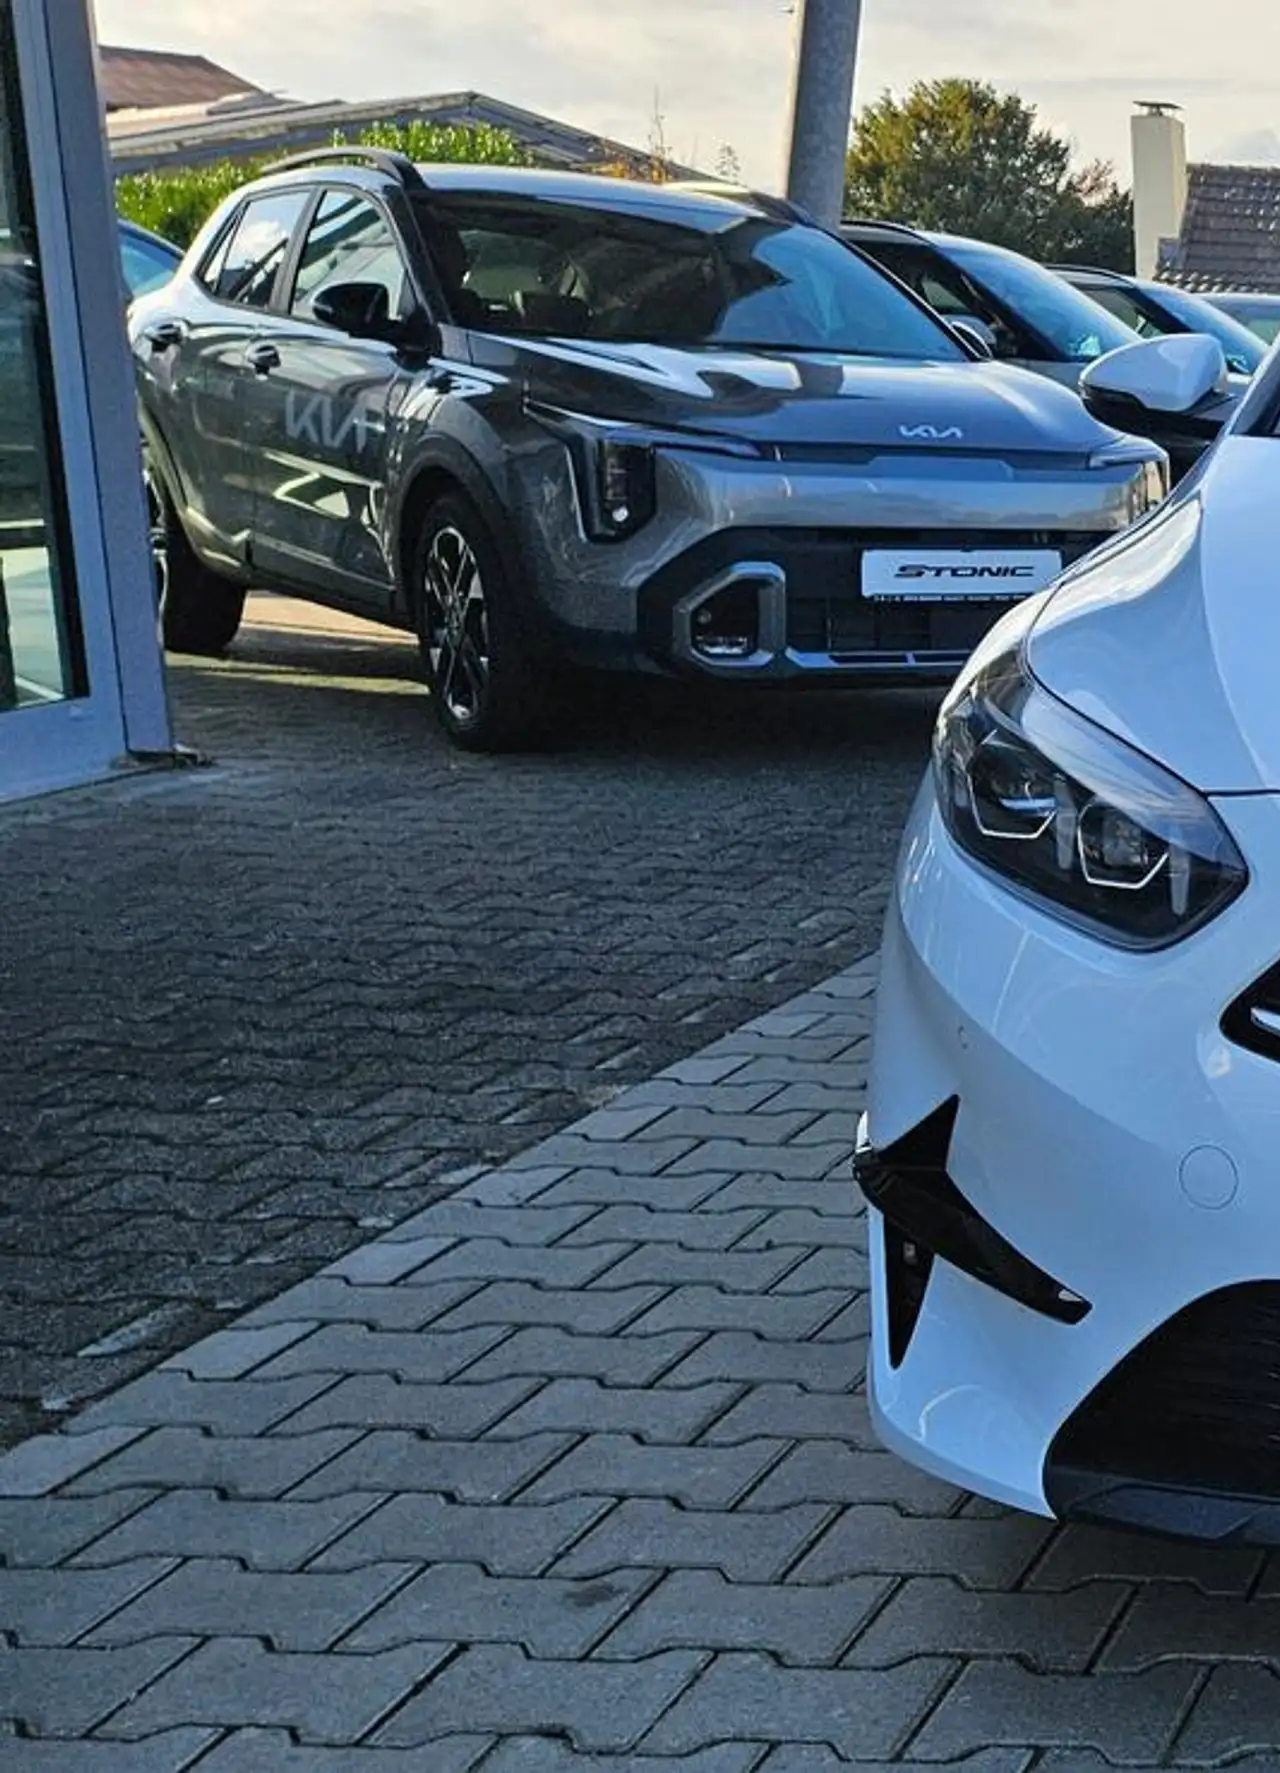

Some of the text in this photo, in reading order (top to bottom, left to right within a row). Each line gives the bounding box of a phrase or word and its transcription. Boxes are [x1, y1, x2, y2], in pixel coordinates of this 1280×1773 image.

[285, 388, 367, 454] KIA
[899, 424, 964, 439] KIA
[894, 564, 1034, 579] STONIC
